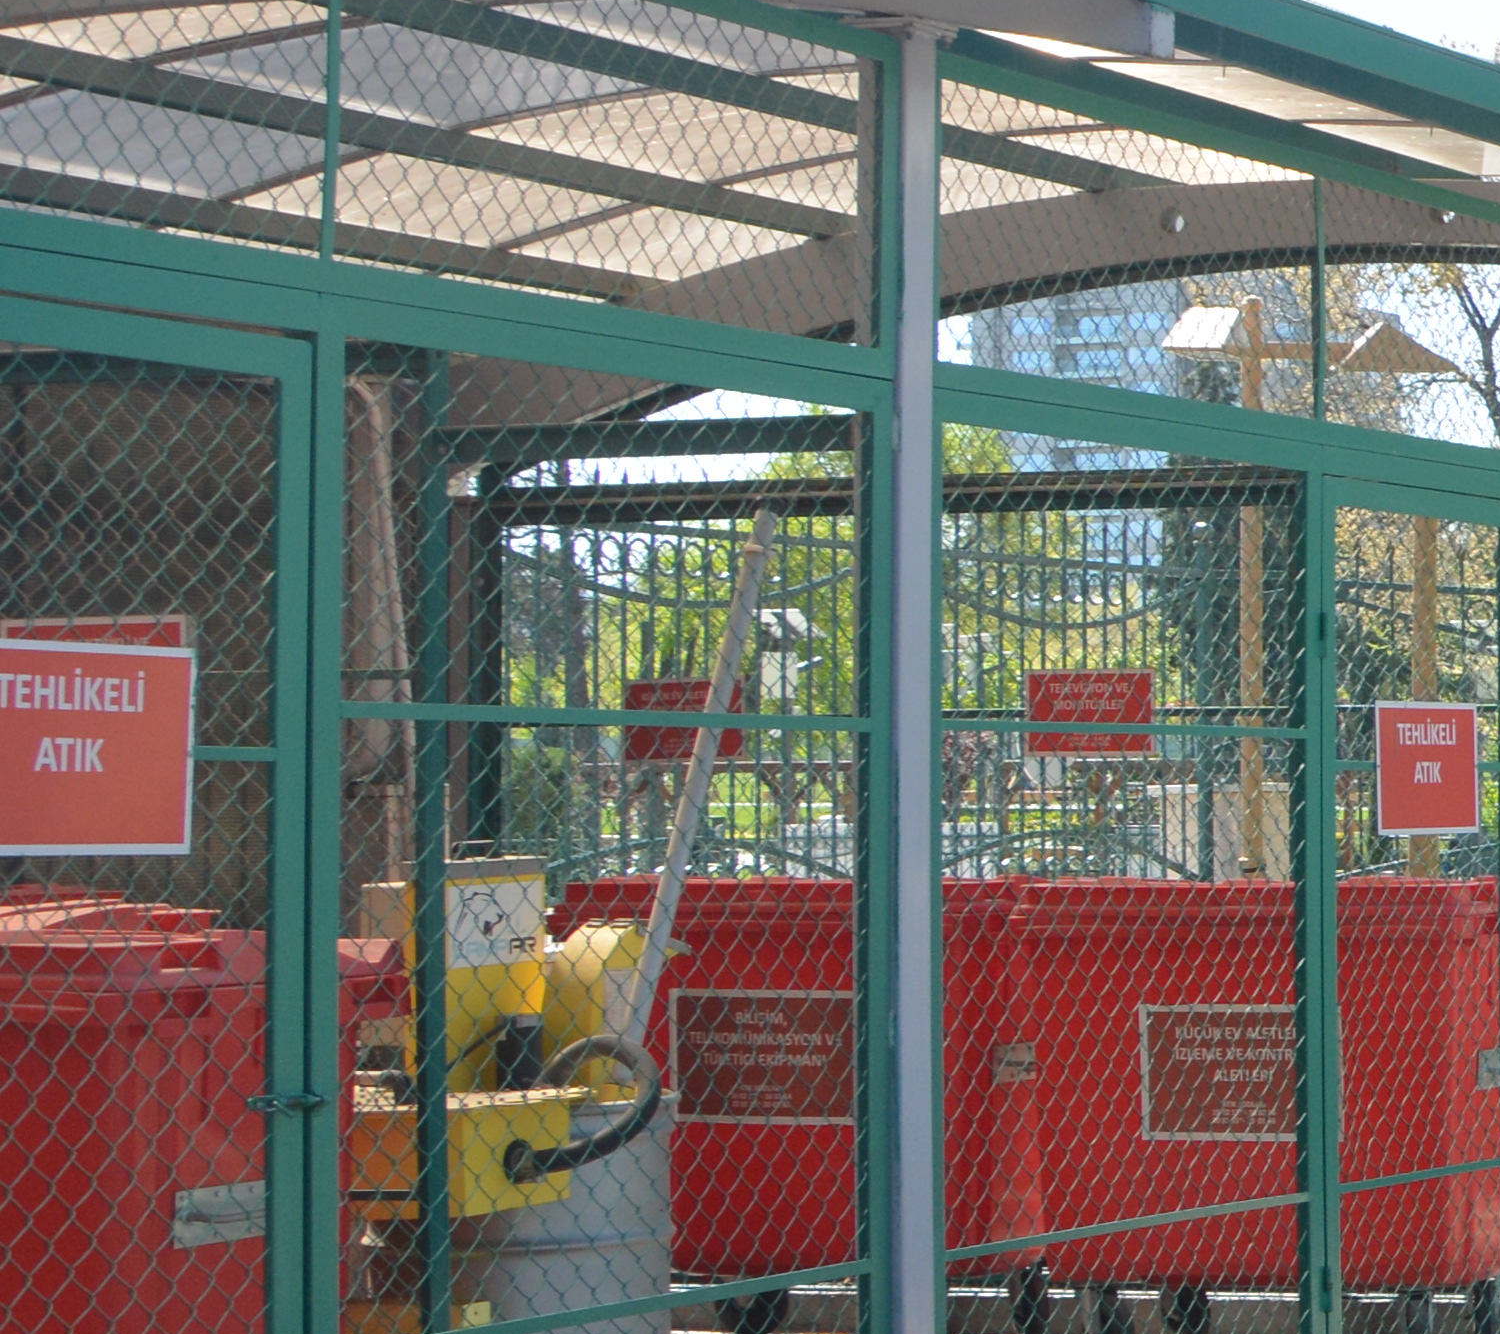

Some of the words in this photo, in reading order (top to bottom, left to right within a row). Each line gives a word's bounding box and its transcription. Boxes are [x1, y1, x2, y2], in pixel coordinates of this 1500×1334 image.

[1396, 718, 1457, 745] TEHLİKELİ
[33, 736, 105, 773] ATIK
[1413, 761, 1442, 784] ATIK
